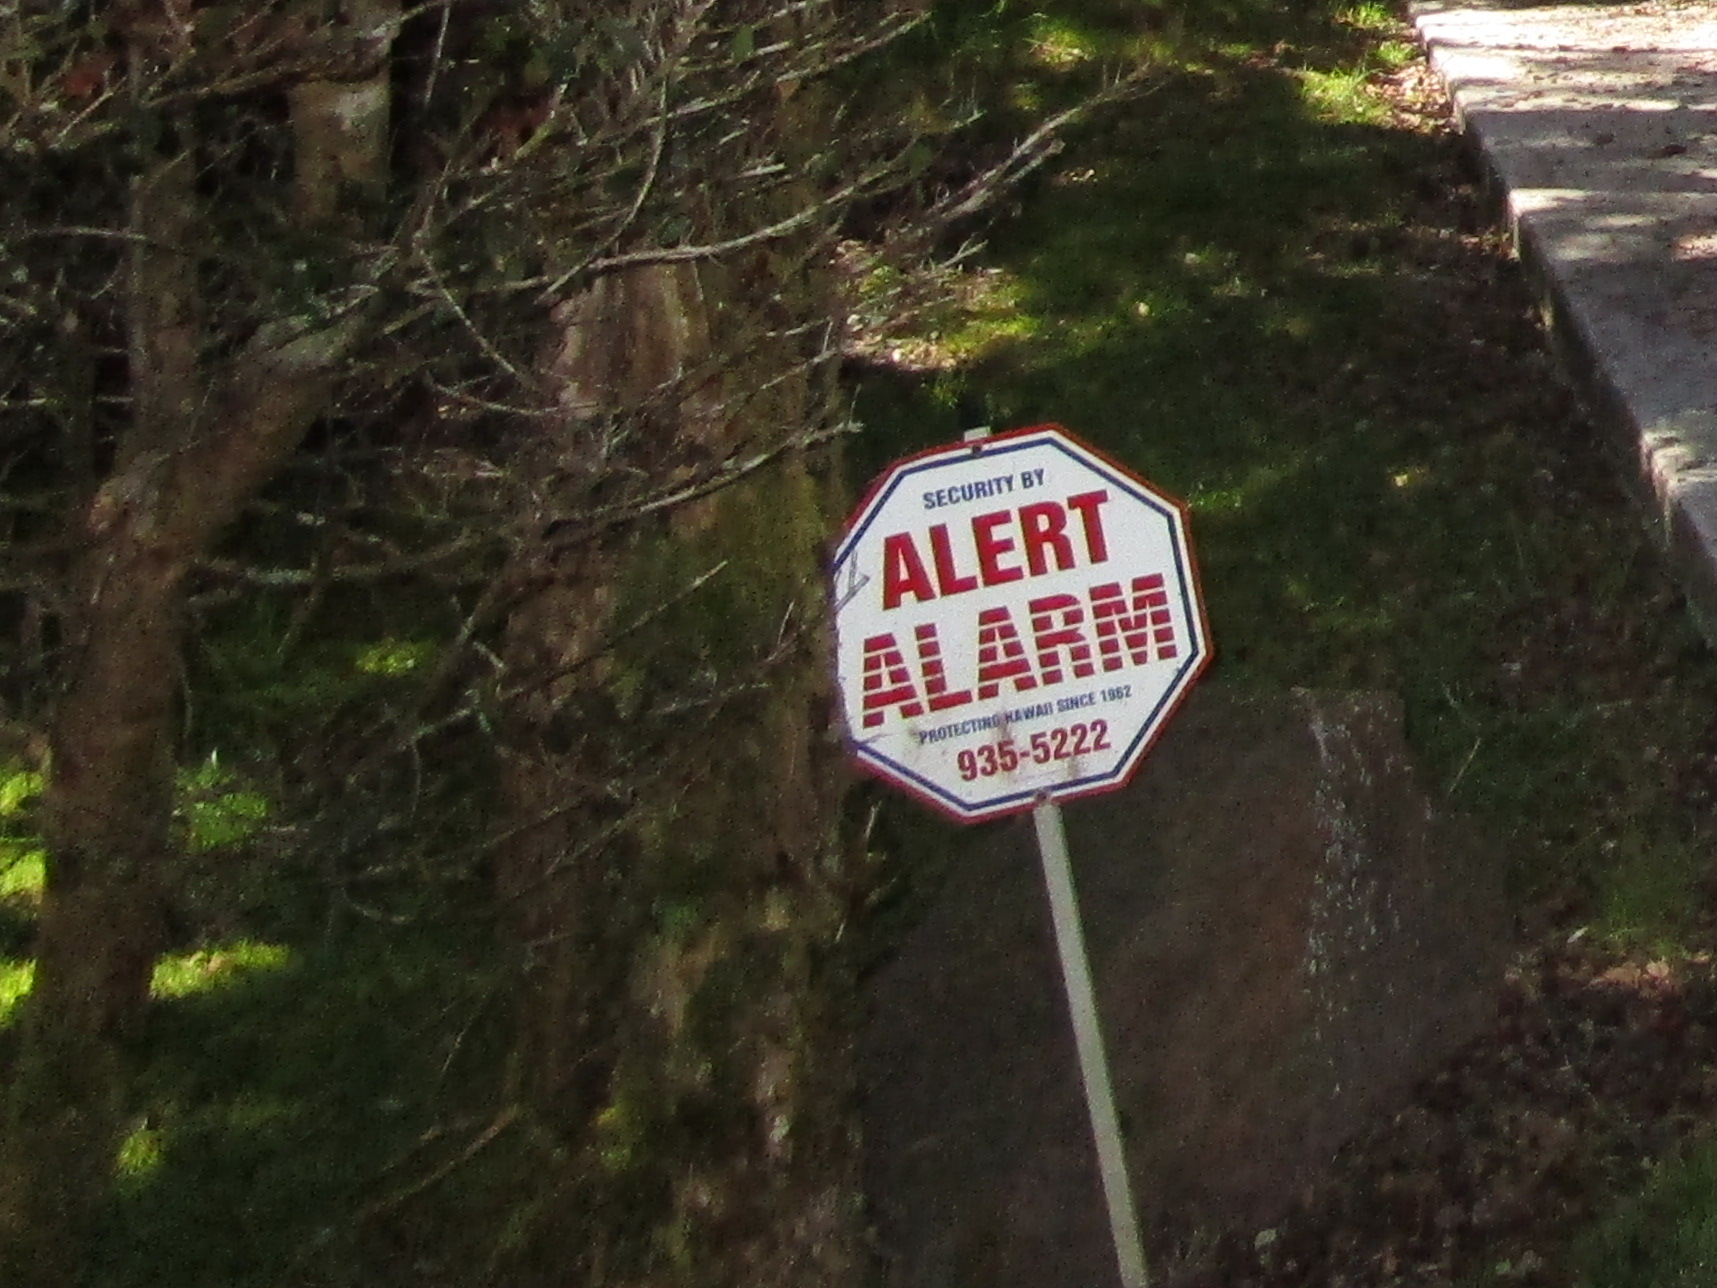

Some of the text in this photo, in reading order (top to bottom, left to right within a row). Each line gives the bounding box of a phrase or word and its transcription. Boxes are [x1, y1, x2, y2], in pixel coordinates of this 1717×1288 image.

[922, 468, 1045, 510] SECURITY BY
[882, 490, 1109, 611] ALERT
[863, 573, 1178, 729] ALARM
[918, 711, 1001, 745] PROTECTING
[1003, 702, 1054, 724] HAWAII
[1056, 691, 1097, 713] SINCE
[957, 719, 1111, 782] 935-5222
